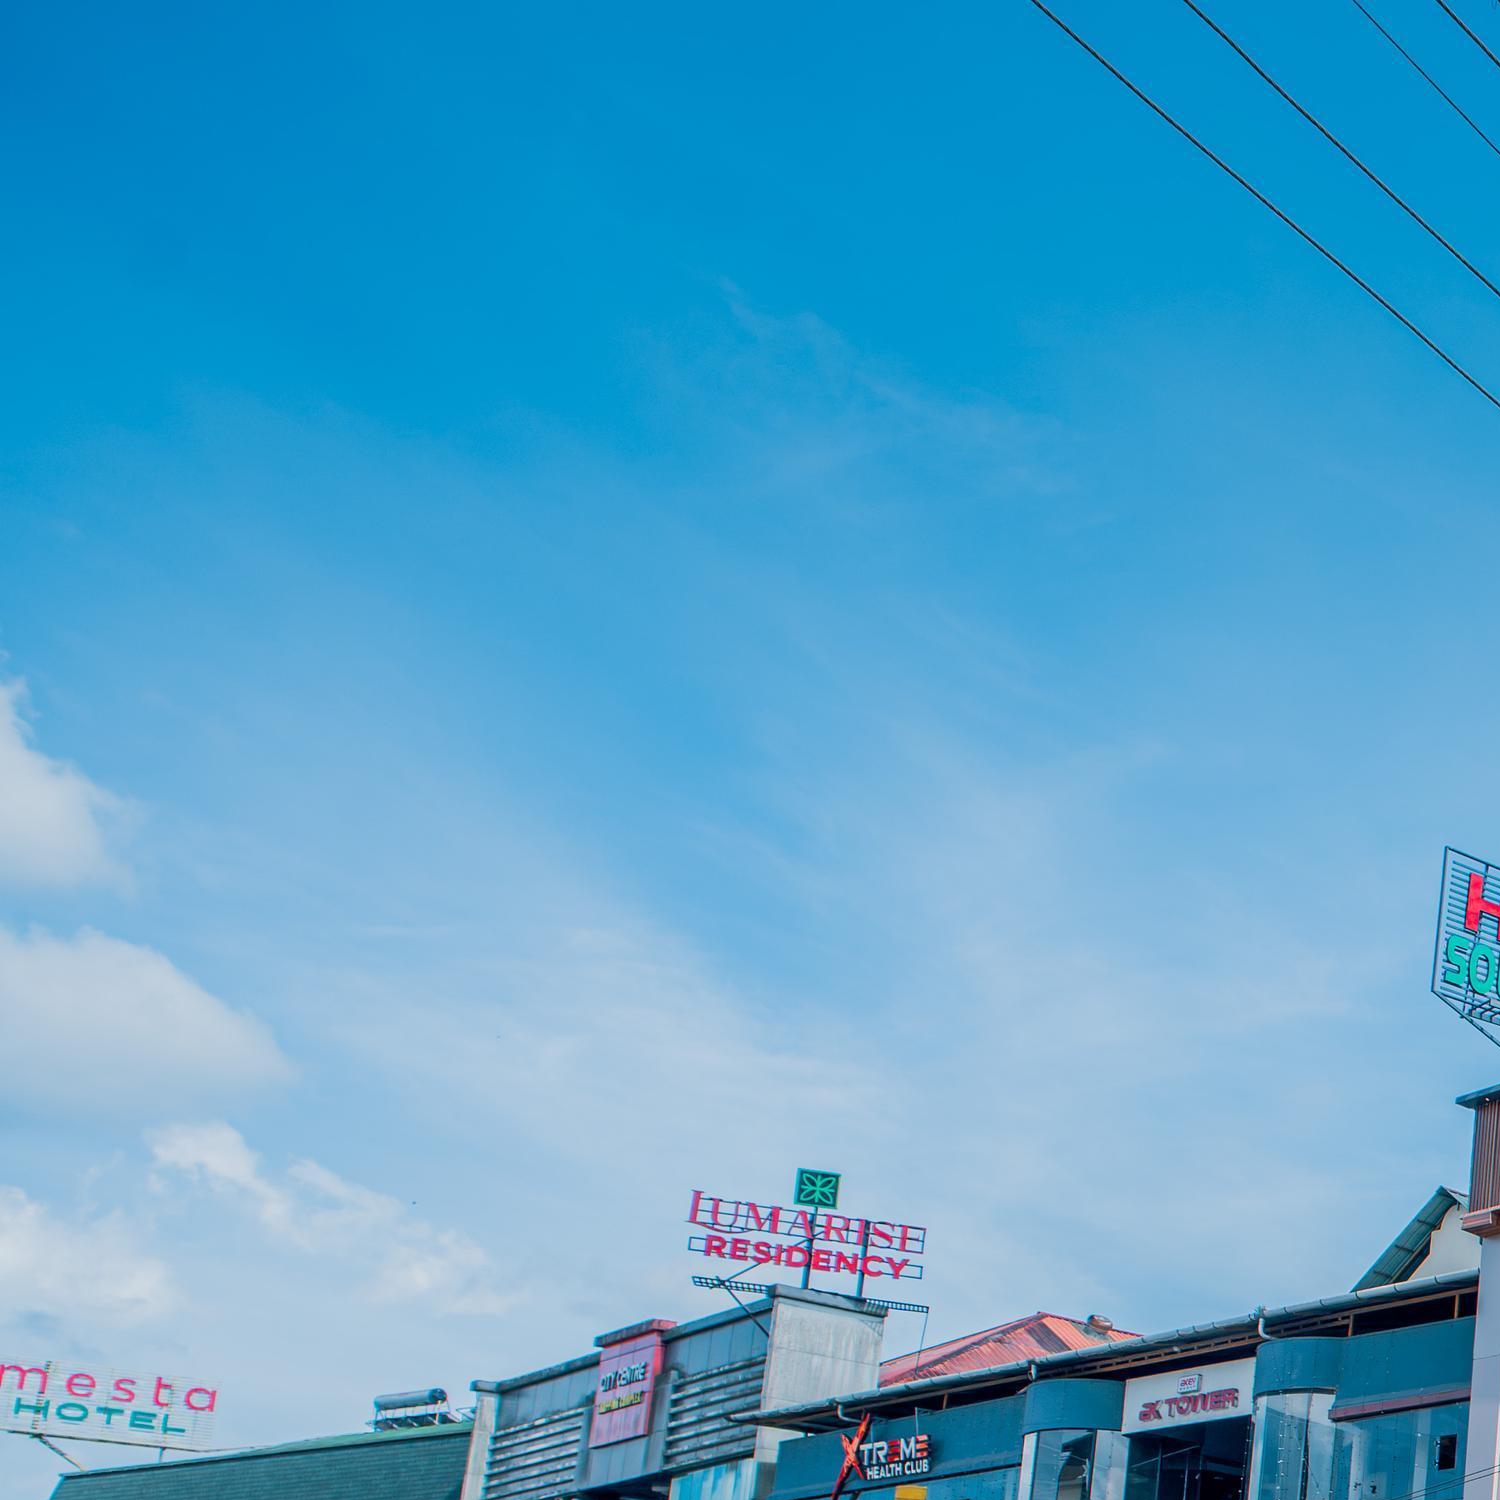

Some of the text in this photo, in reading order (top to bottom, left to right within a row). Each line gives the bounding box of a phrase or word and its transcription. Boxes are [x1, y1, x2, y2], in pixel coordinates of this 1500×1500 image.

[686, 1189, 927, 1254] LUMARISE
[705, 1234, 909, 1279] RESIDENCY
[0, 1364, 217, 1412] mesta
[1164, 1388, 1238, 1416] TOWER
[14, 1397, 186, 1434] HOTEL
[866, 1460, 929, 1480] HEALTH CLUB
